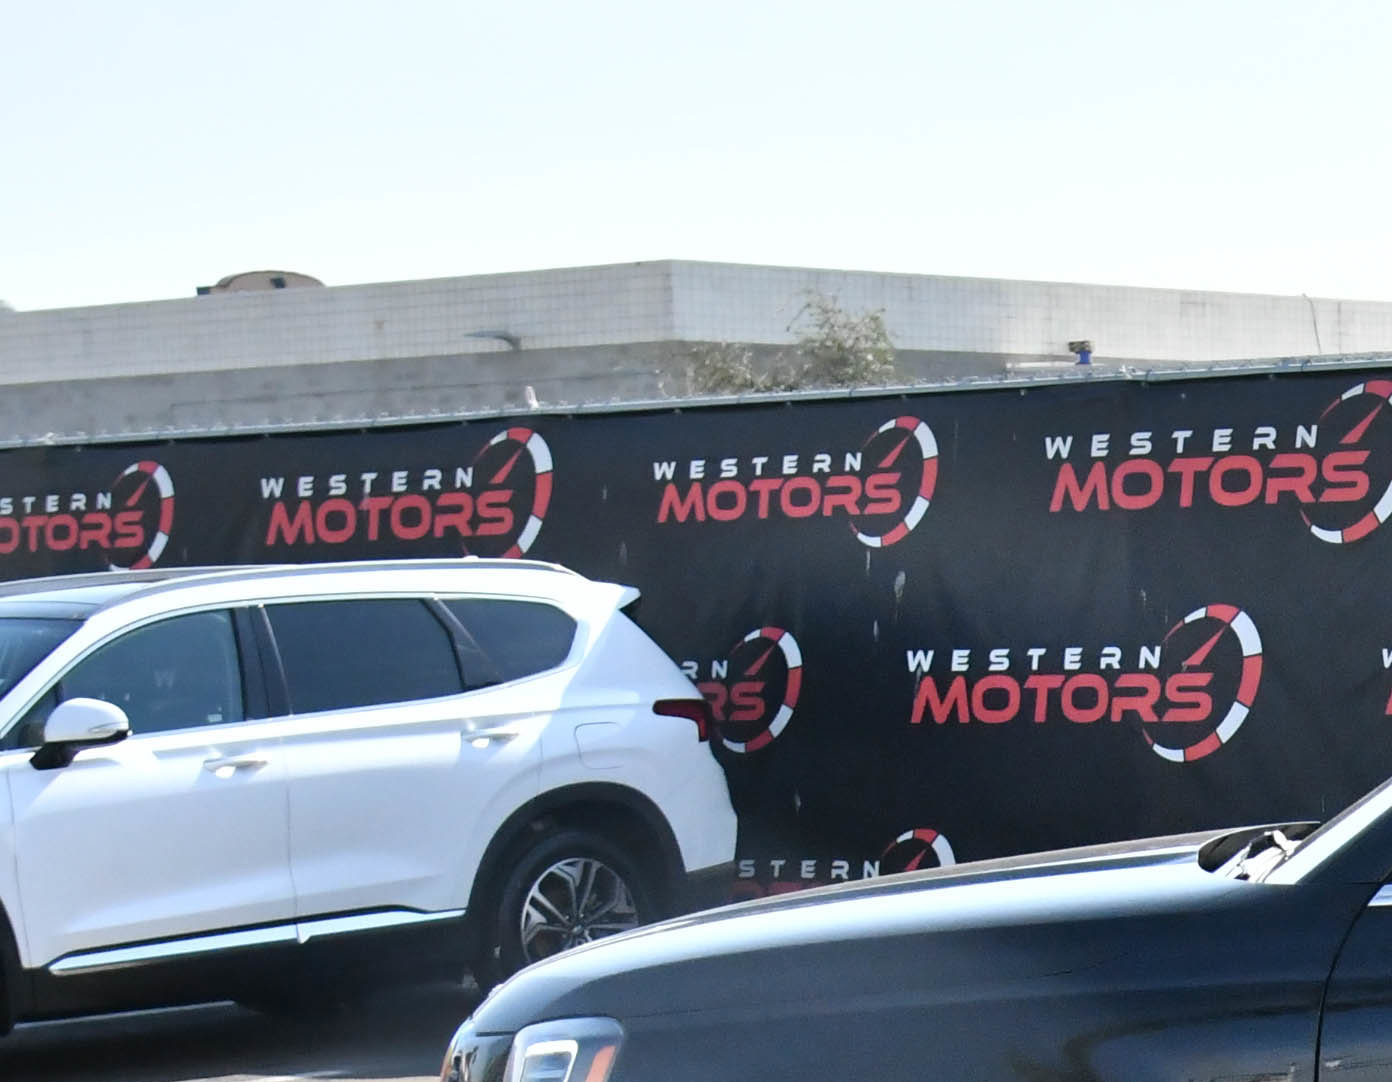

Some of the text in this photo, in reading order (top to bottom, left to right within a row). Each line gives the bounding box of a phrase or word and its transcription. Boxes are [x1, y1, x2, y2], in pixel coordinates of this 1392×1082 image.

[1045, 424, 1318, 460] WESTERN
[261, 466, 473, 499] WESTERN
[653, 452, 862, 481] WESTERN
[1049, 450, 1370, 513] MOTORS
[266, 490, 514, 545] MOTORS
[657, 472, 902, 523] MOTORS
[907, 645, 1162, 673] WESTERN
[911, 671, 1215, 724] MOTORS
